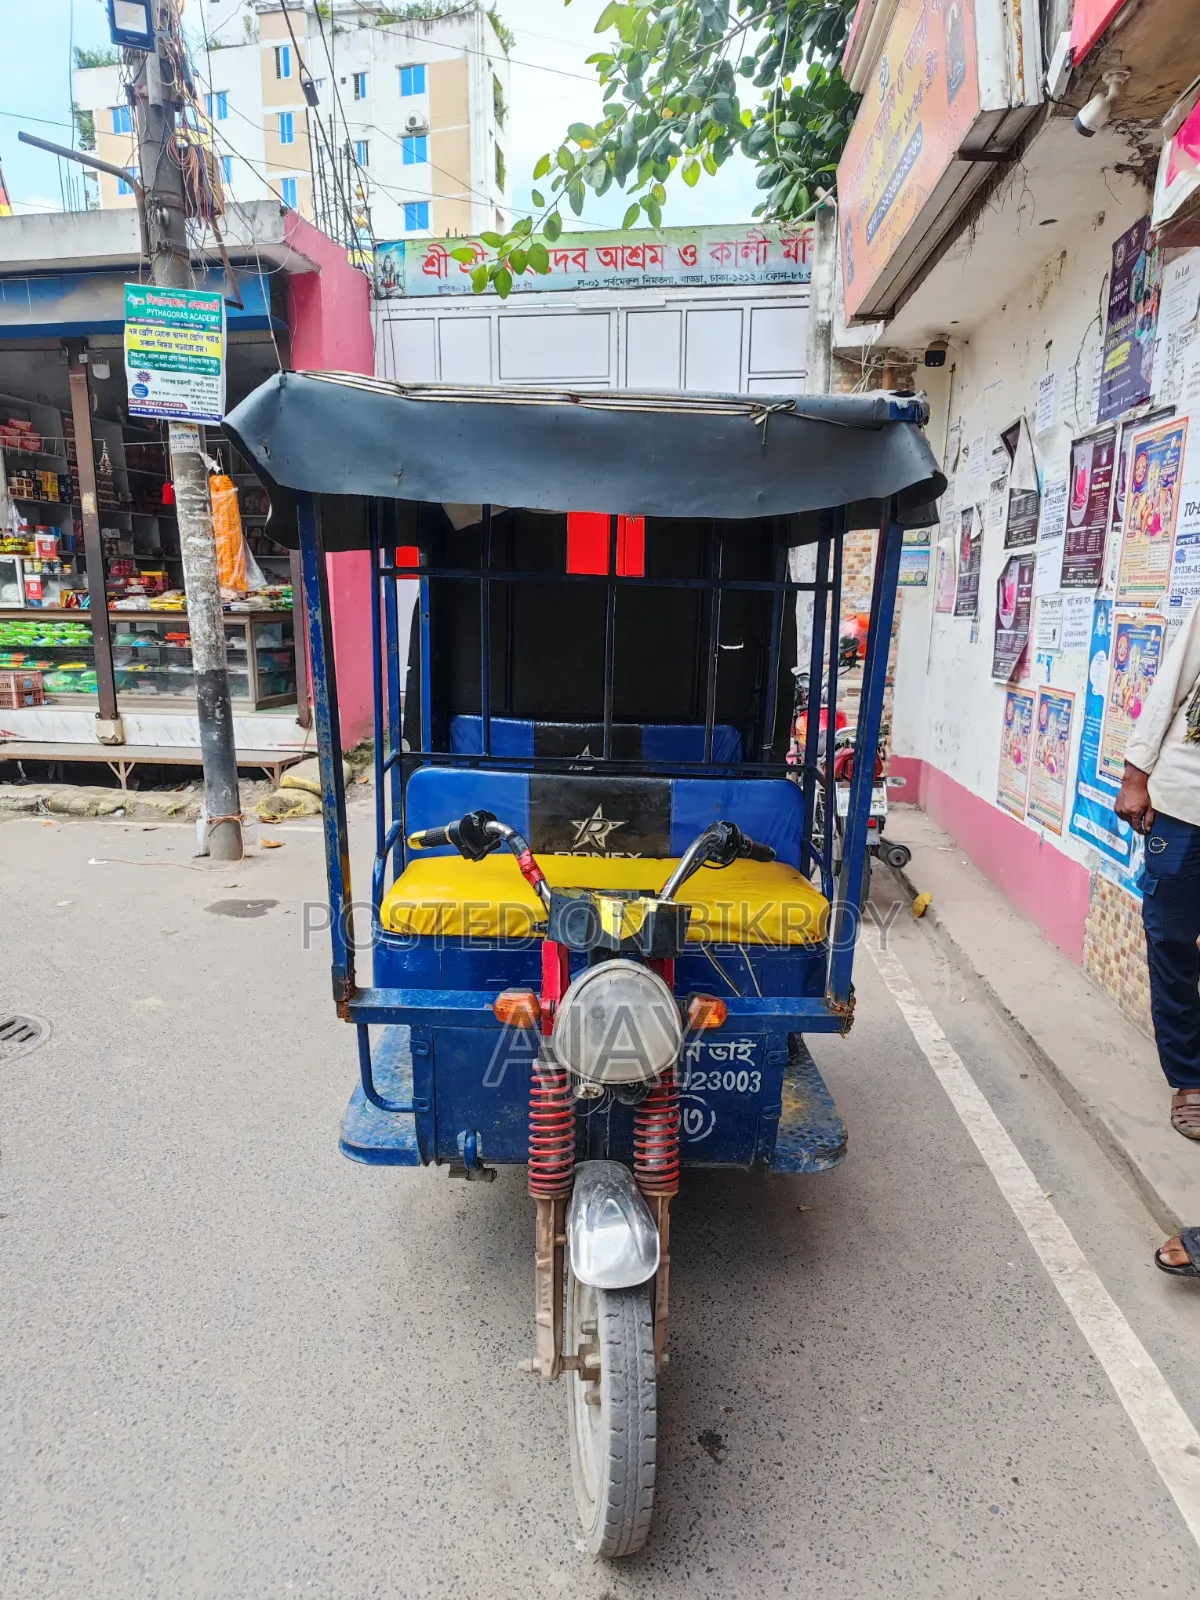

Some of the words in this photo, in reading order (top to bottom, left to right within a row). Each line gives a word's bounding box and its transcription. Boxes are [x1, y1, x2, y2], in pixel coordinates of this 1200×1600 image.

[421, 243, 450, 280] শ্রী
[595, 242, 668, 272] আশ্রম
[677, 244, 698, 267] ও
[708, 227, 772, 268] কালী
[146, 308, 188, 319] PYTHAGORAS
[189, 312, 219, 322] ACADEMY
[708, 1038, 757, 1066] ভাই
